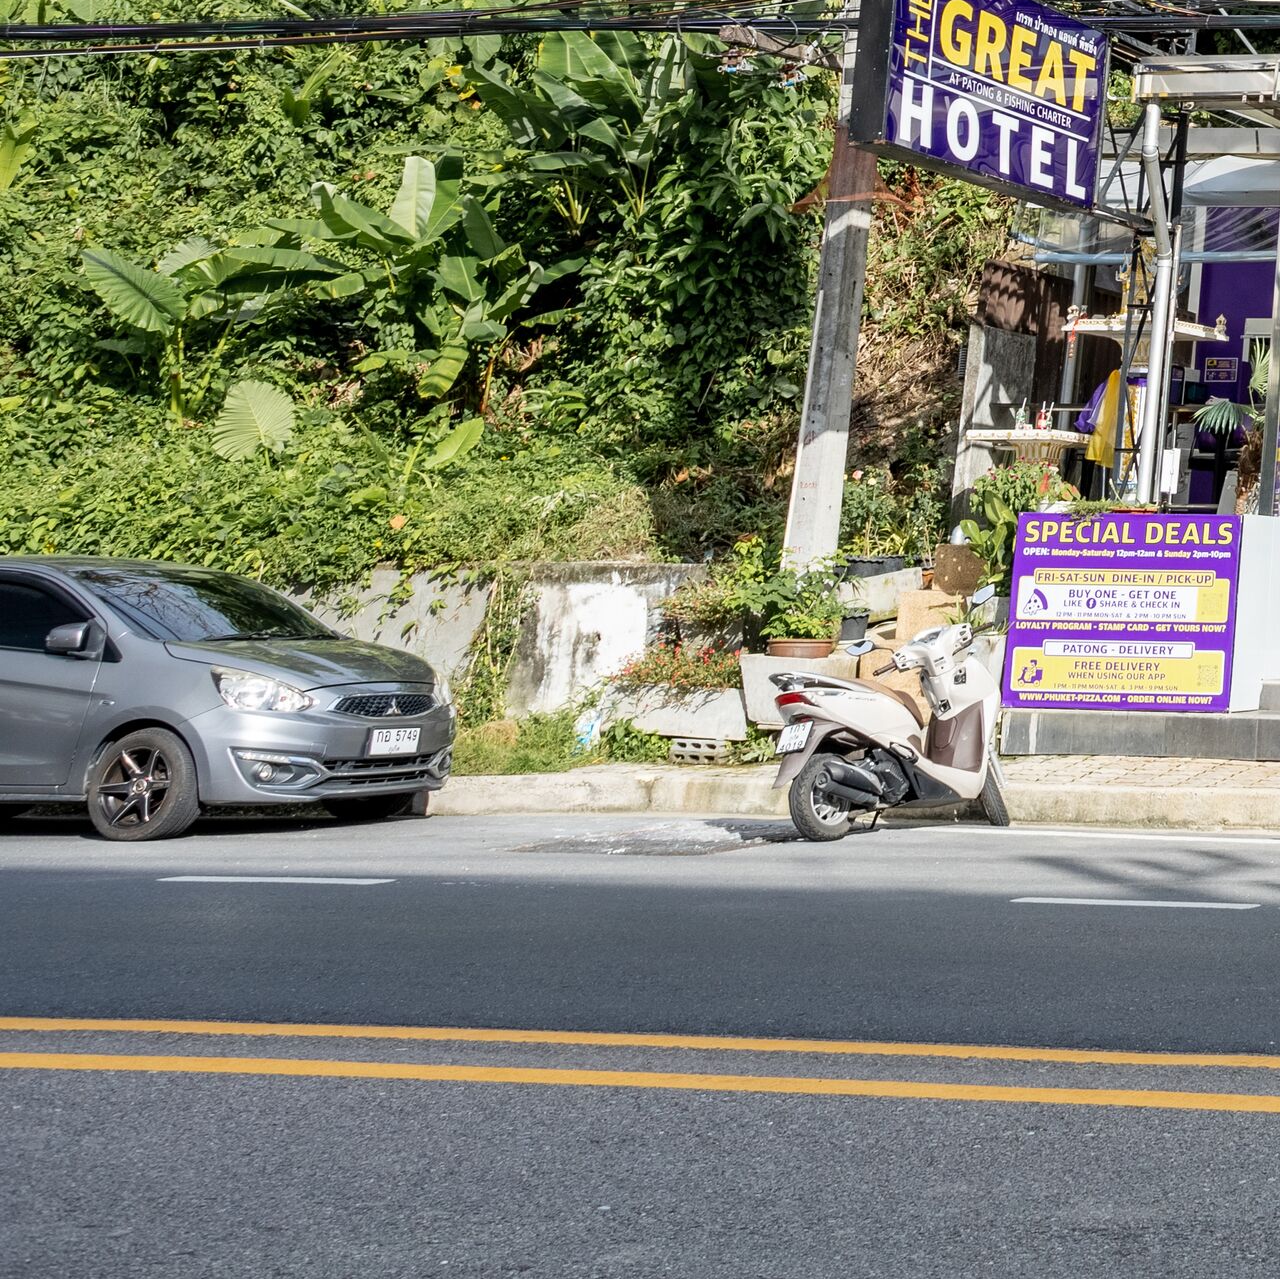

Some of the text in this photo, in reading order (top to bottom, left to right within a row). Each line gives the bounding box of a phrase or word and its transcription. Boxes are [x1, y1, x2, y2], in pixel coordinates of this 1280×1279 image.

[950, 72, 1072, 129] AT PATONG & FISHING CHARTER
[899, 76, 1086, 201] HOTEL
[1024, 521, 1233, 545] SPECIAL DEALS
[1023, 547, 1050, 556] OPEN:
[1051, 548, 1115, 557] Monday-Saturday
[1116, 549, 1155, 558] 12pm-12am
[1164, 550, 1191, 559] Sunday
[1192, 550, 1231, 559] 2pm-10pm
[1038, 573, 1212, 584] FRI-SAT-SUN DINE-IN PICK-UP
[1068, 589, 1177, 600] BUY ONE GET ONE
[1099, 600, 1128, 608] SHARE
[1139, 601, 1168, 609] CHECK
[1171, 601, 1180, 609] IN
[1016, 621, 1051, 630] LOYALTY
[1052, 622, 1092, 631] PROGRAM
[1098, 623, 1126, 631] STAMP
[1127, 623, 1149, 632] CARD
[1155, 624, 1172, 632] GET
[1173, 624, 1201, 633] YOURS
[1063, 644, 1174, 655] PATONG DELIVERY
[1074, 661, 1160, 671] FREE DELIVERY
[1097, 672, 1124, 680] USING
[1019, 692, 1121, 703] WWW.PHUKET-PIZZA.COM
[1127, 695, 1155, 703] ORDER
[1156, 696, 1187, 704] ONLINE
[396, 729, 418, 742] 5749
